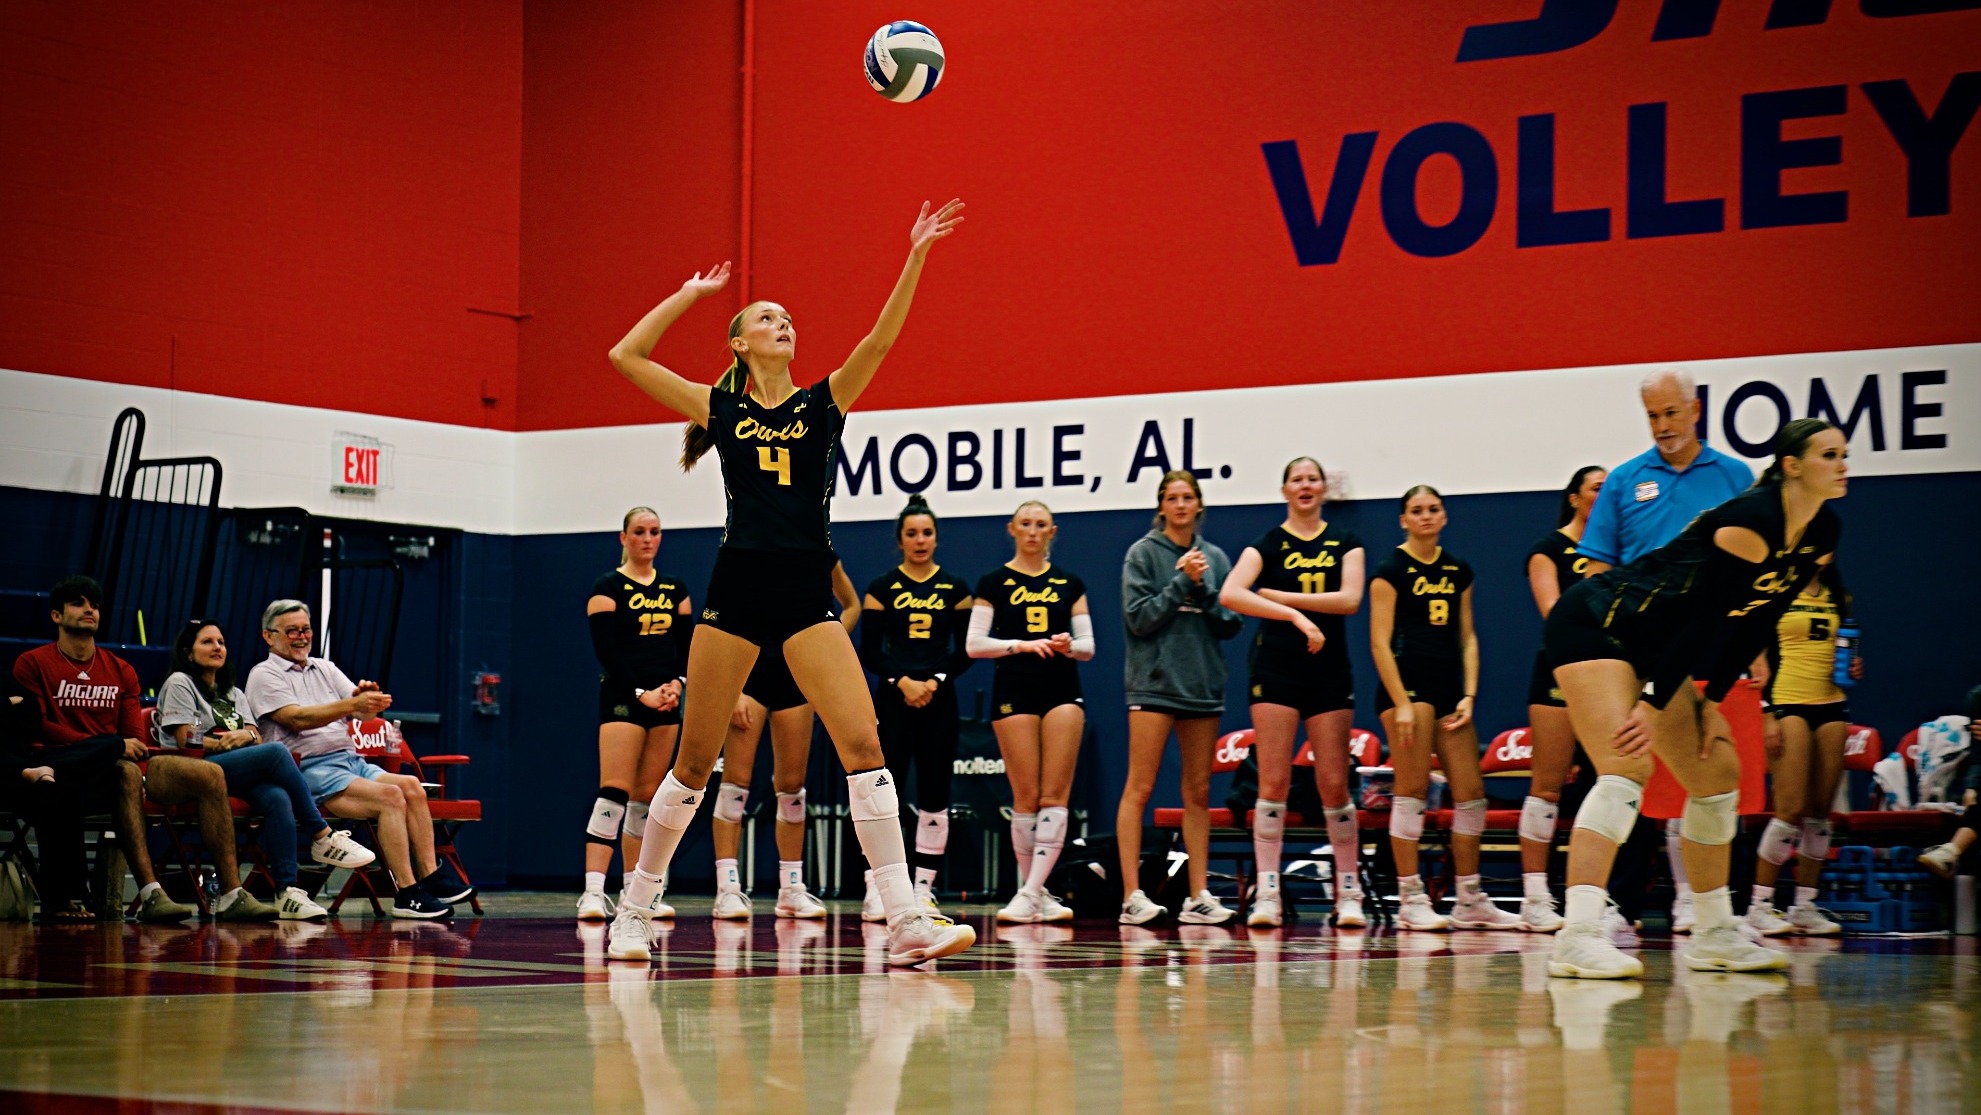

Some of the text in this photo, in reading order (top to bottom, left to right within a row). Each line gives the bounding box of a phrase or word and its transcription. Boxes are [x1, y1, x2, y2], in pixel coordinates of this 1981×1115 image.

[1260, 71, 1981, 267] VOLLEY
[1126, 418, 1233, 484] AL.
[344, 446, 380, 486] EXIT
[755, 446, 792, 486] 4
[1283, 550, 1337, 570] Owls
[1297, 572, 1326, 594] 11
[1412, 575, 1456, 596] Owls
[628, 592, 675, 610] Owls
[893, 591, 947, 610] Owls
[1009, 585, 1061, 606] Owls
[638, 612, 673, 636] 12
[1025, 606, 1049, 633] 9
[1428, 599, 1450, 626] 8
[908, 612, 933, 639] 2
[1809, 617, 1830, 641] 5
[52, 679, 119, 700] JAGUAR
[58, 698, 115, 709] VOLLEYBALL
